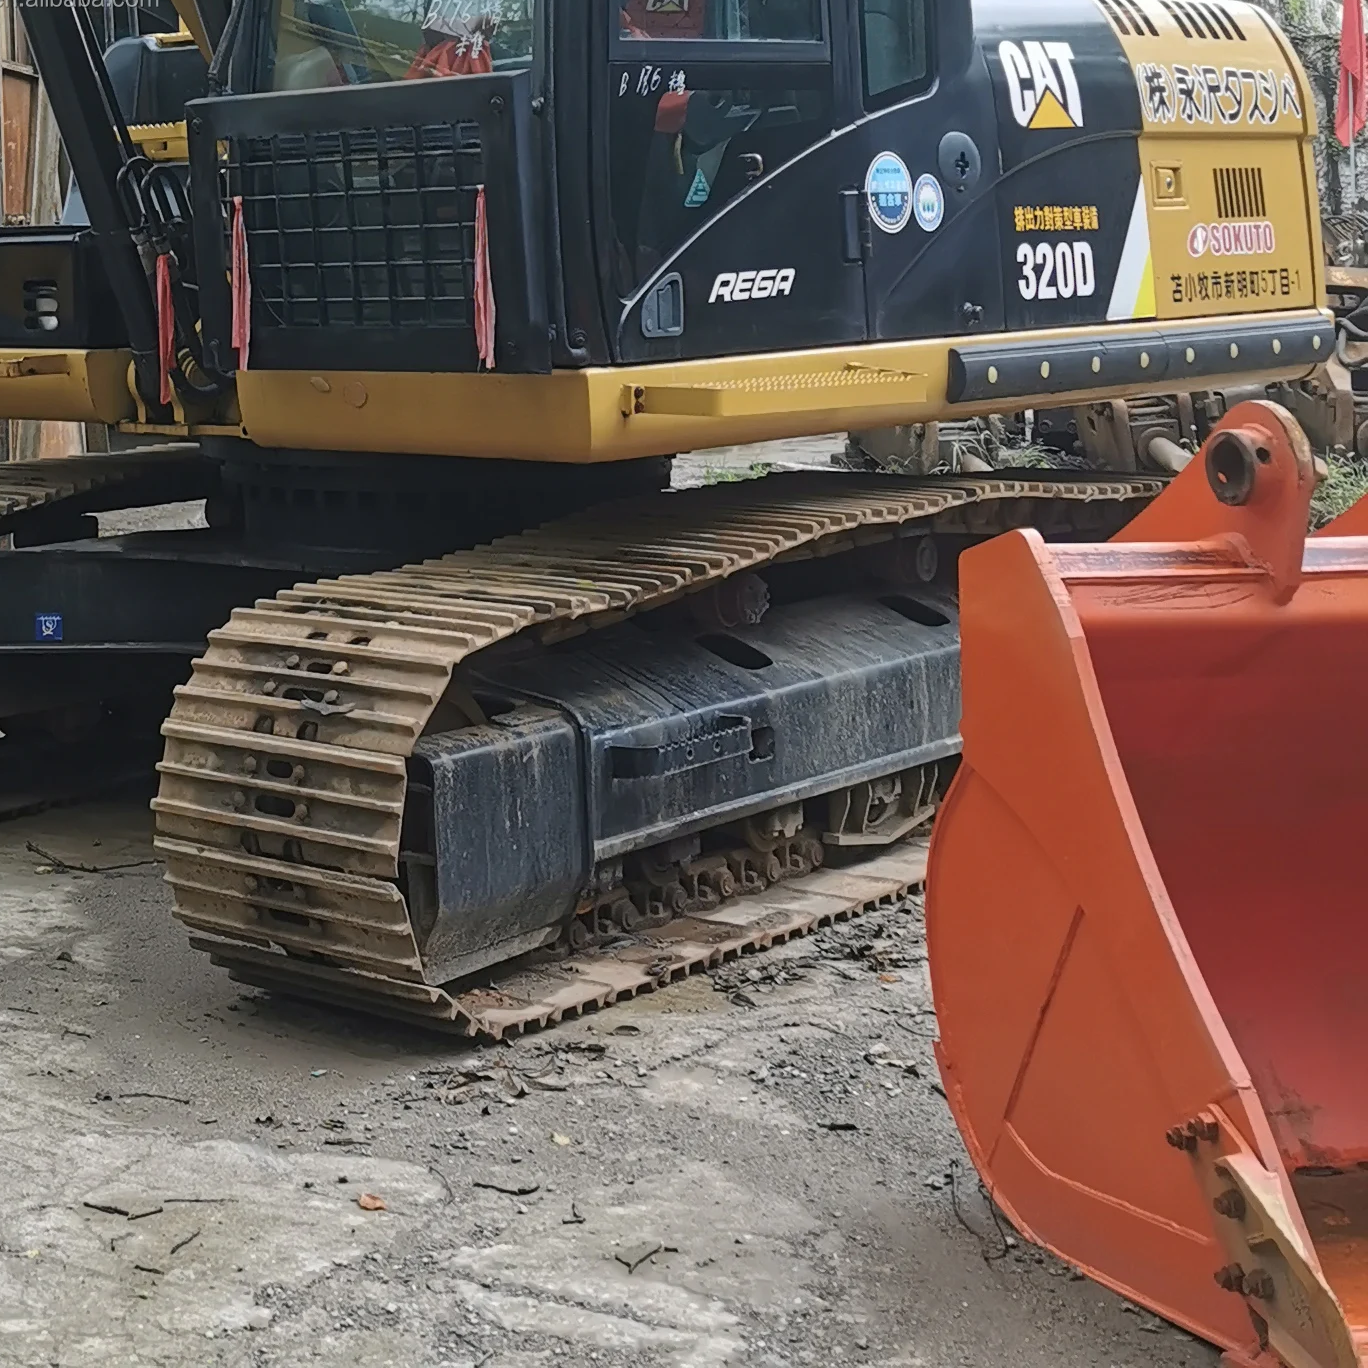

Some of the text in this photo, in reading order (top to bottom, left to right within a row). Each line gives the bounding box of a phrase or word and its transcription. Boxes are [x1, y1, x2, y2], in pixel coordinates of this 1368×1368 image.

[618, 72, 630, 97] B
[998, 40, 1084, 128] CAT
[1210, 222, 1275, 255] SOKUTO
[707, 267, 796, 304] REGA
[1016, 240, 1096, 301] 320D
